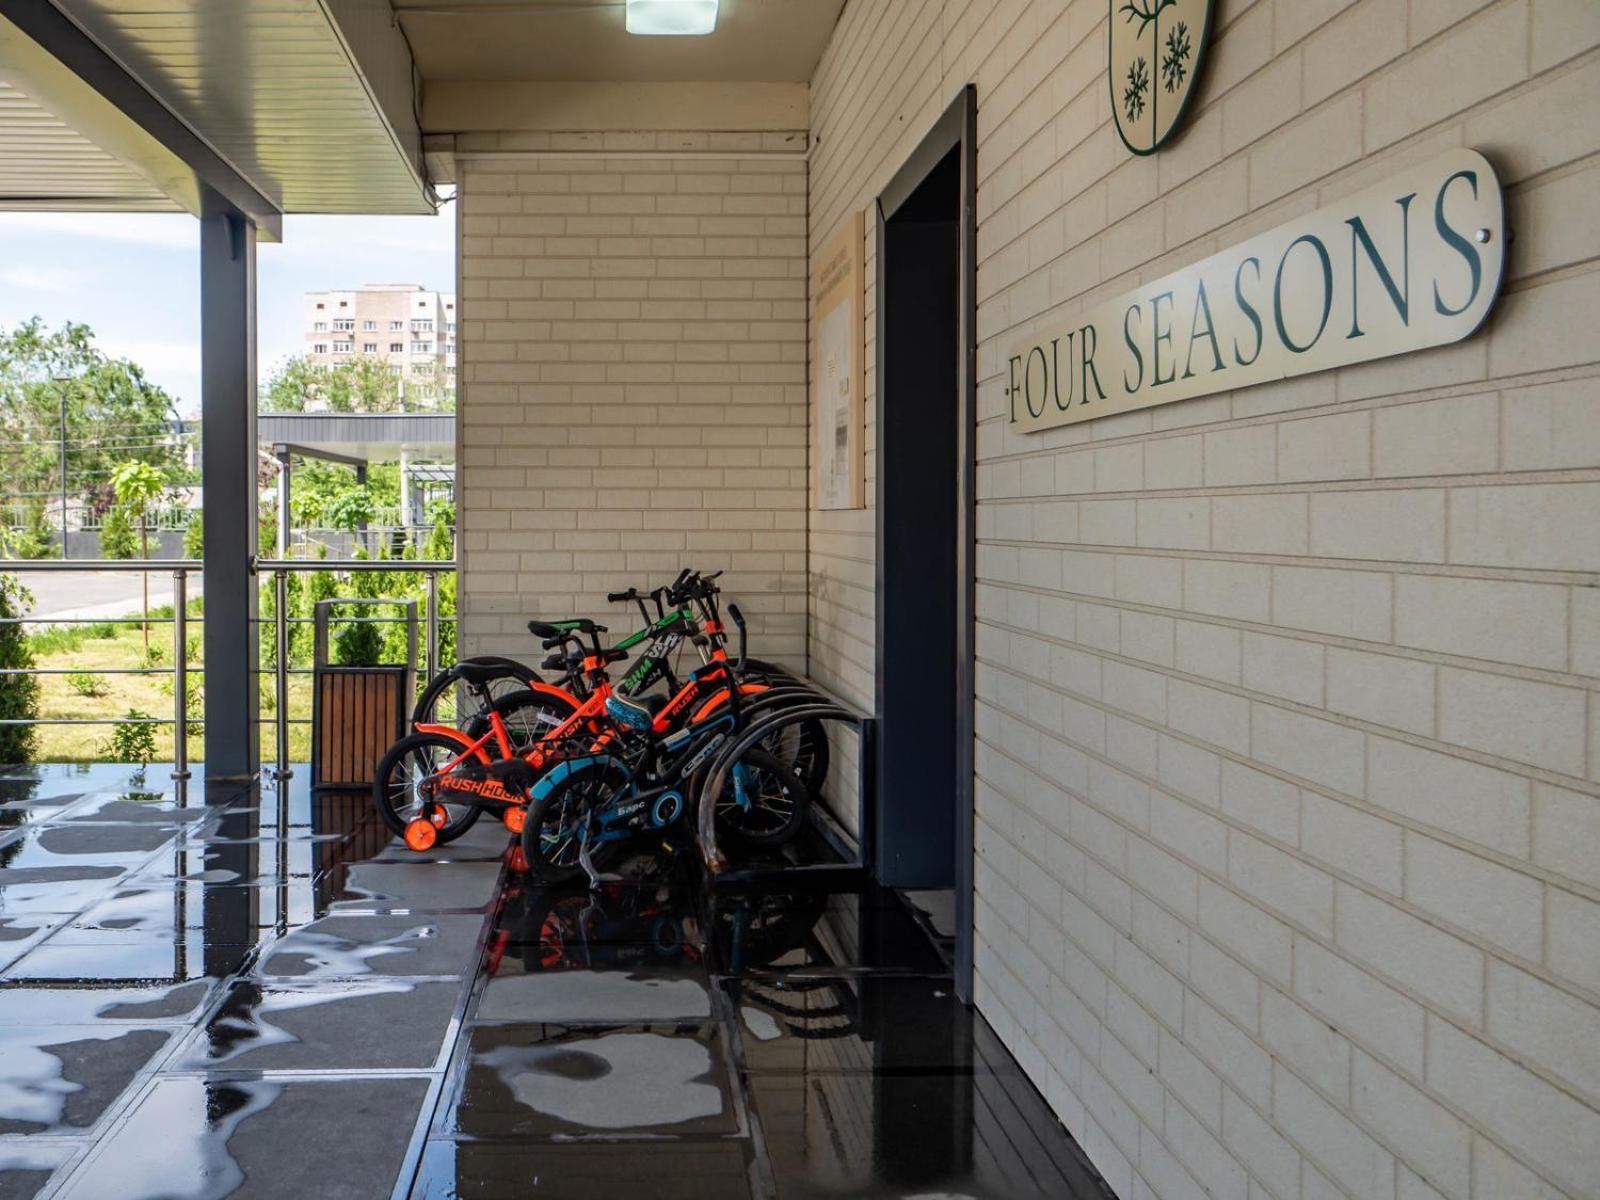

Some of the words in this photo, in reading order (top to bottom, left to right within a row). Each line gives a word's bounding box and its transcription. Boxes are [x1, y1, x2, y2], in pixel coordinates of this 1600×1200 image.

[1008, 324, 1107, 424] FOUR
[1122, 170, 1483, 393] SEASONS
[671, 686, 699, 716] RUSH
[440, 776, 482, 793] RUSH
